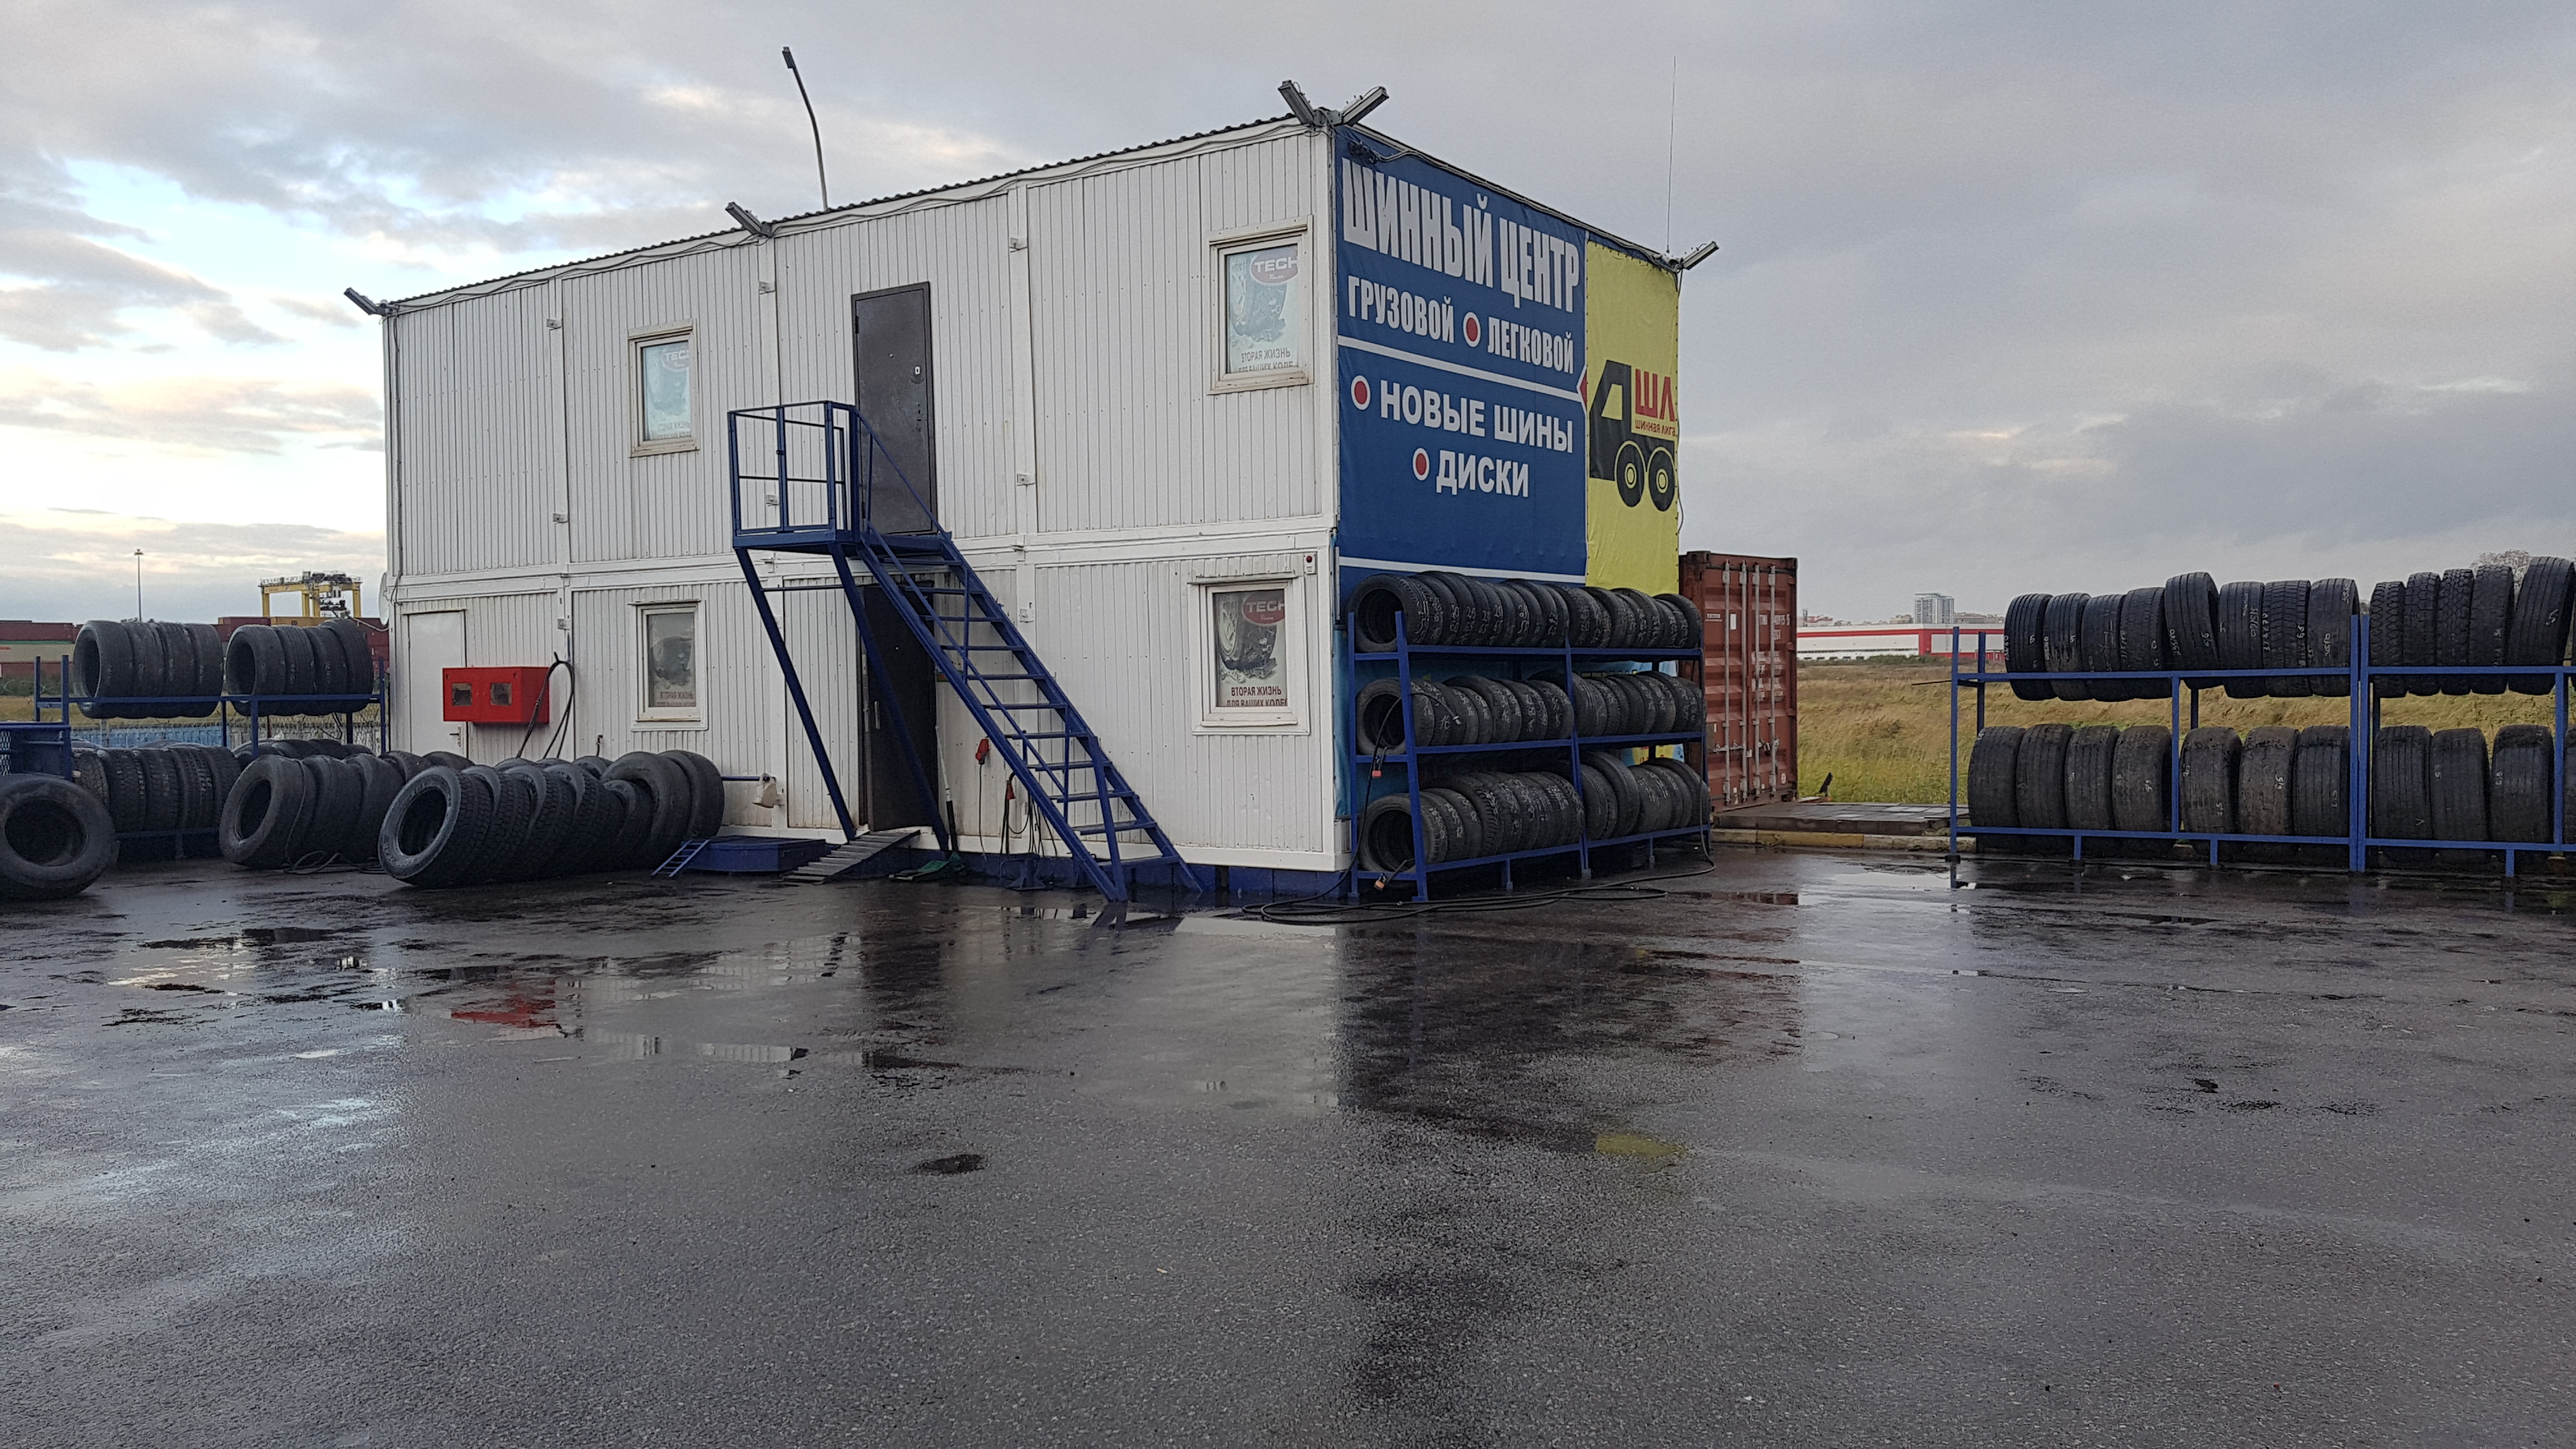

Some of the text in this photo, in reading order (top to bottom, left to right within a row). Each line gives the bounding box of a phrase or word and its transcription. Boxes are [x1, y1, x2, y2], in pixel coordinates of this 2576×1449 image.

[1341, 157, 1579, 312] ШИННЫЙ ЦЕНТР
[1347, 275, 1574, 374] ГРУЗОВОЙ ЛЕГКОВОЙ
[664, 349, 689, 362] TEC
[1241, 348, 1291, 363] ВТОРАЯ ЖИЗНЬ
[1380, 379, 1573, 454] НОВЫЕ ШИНЫ
[1635, 368, 1675, 422] ШЛ
[1635, 419, 1676, 436] ШИННАЯ ЛИГА
[1436, 449, 1529, 497] ДИСКИ
[1231, 686, 1282, 696] ВТОРАЯ ЖИЗНЬ
